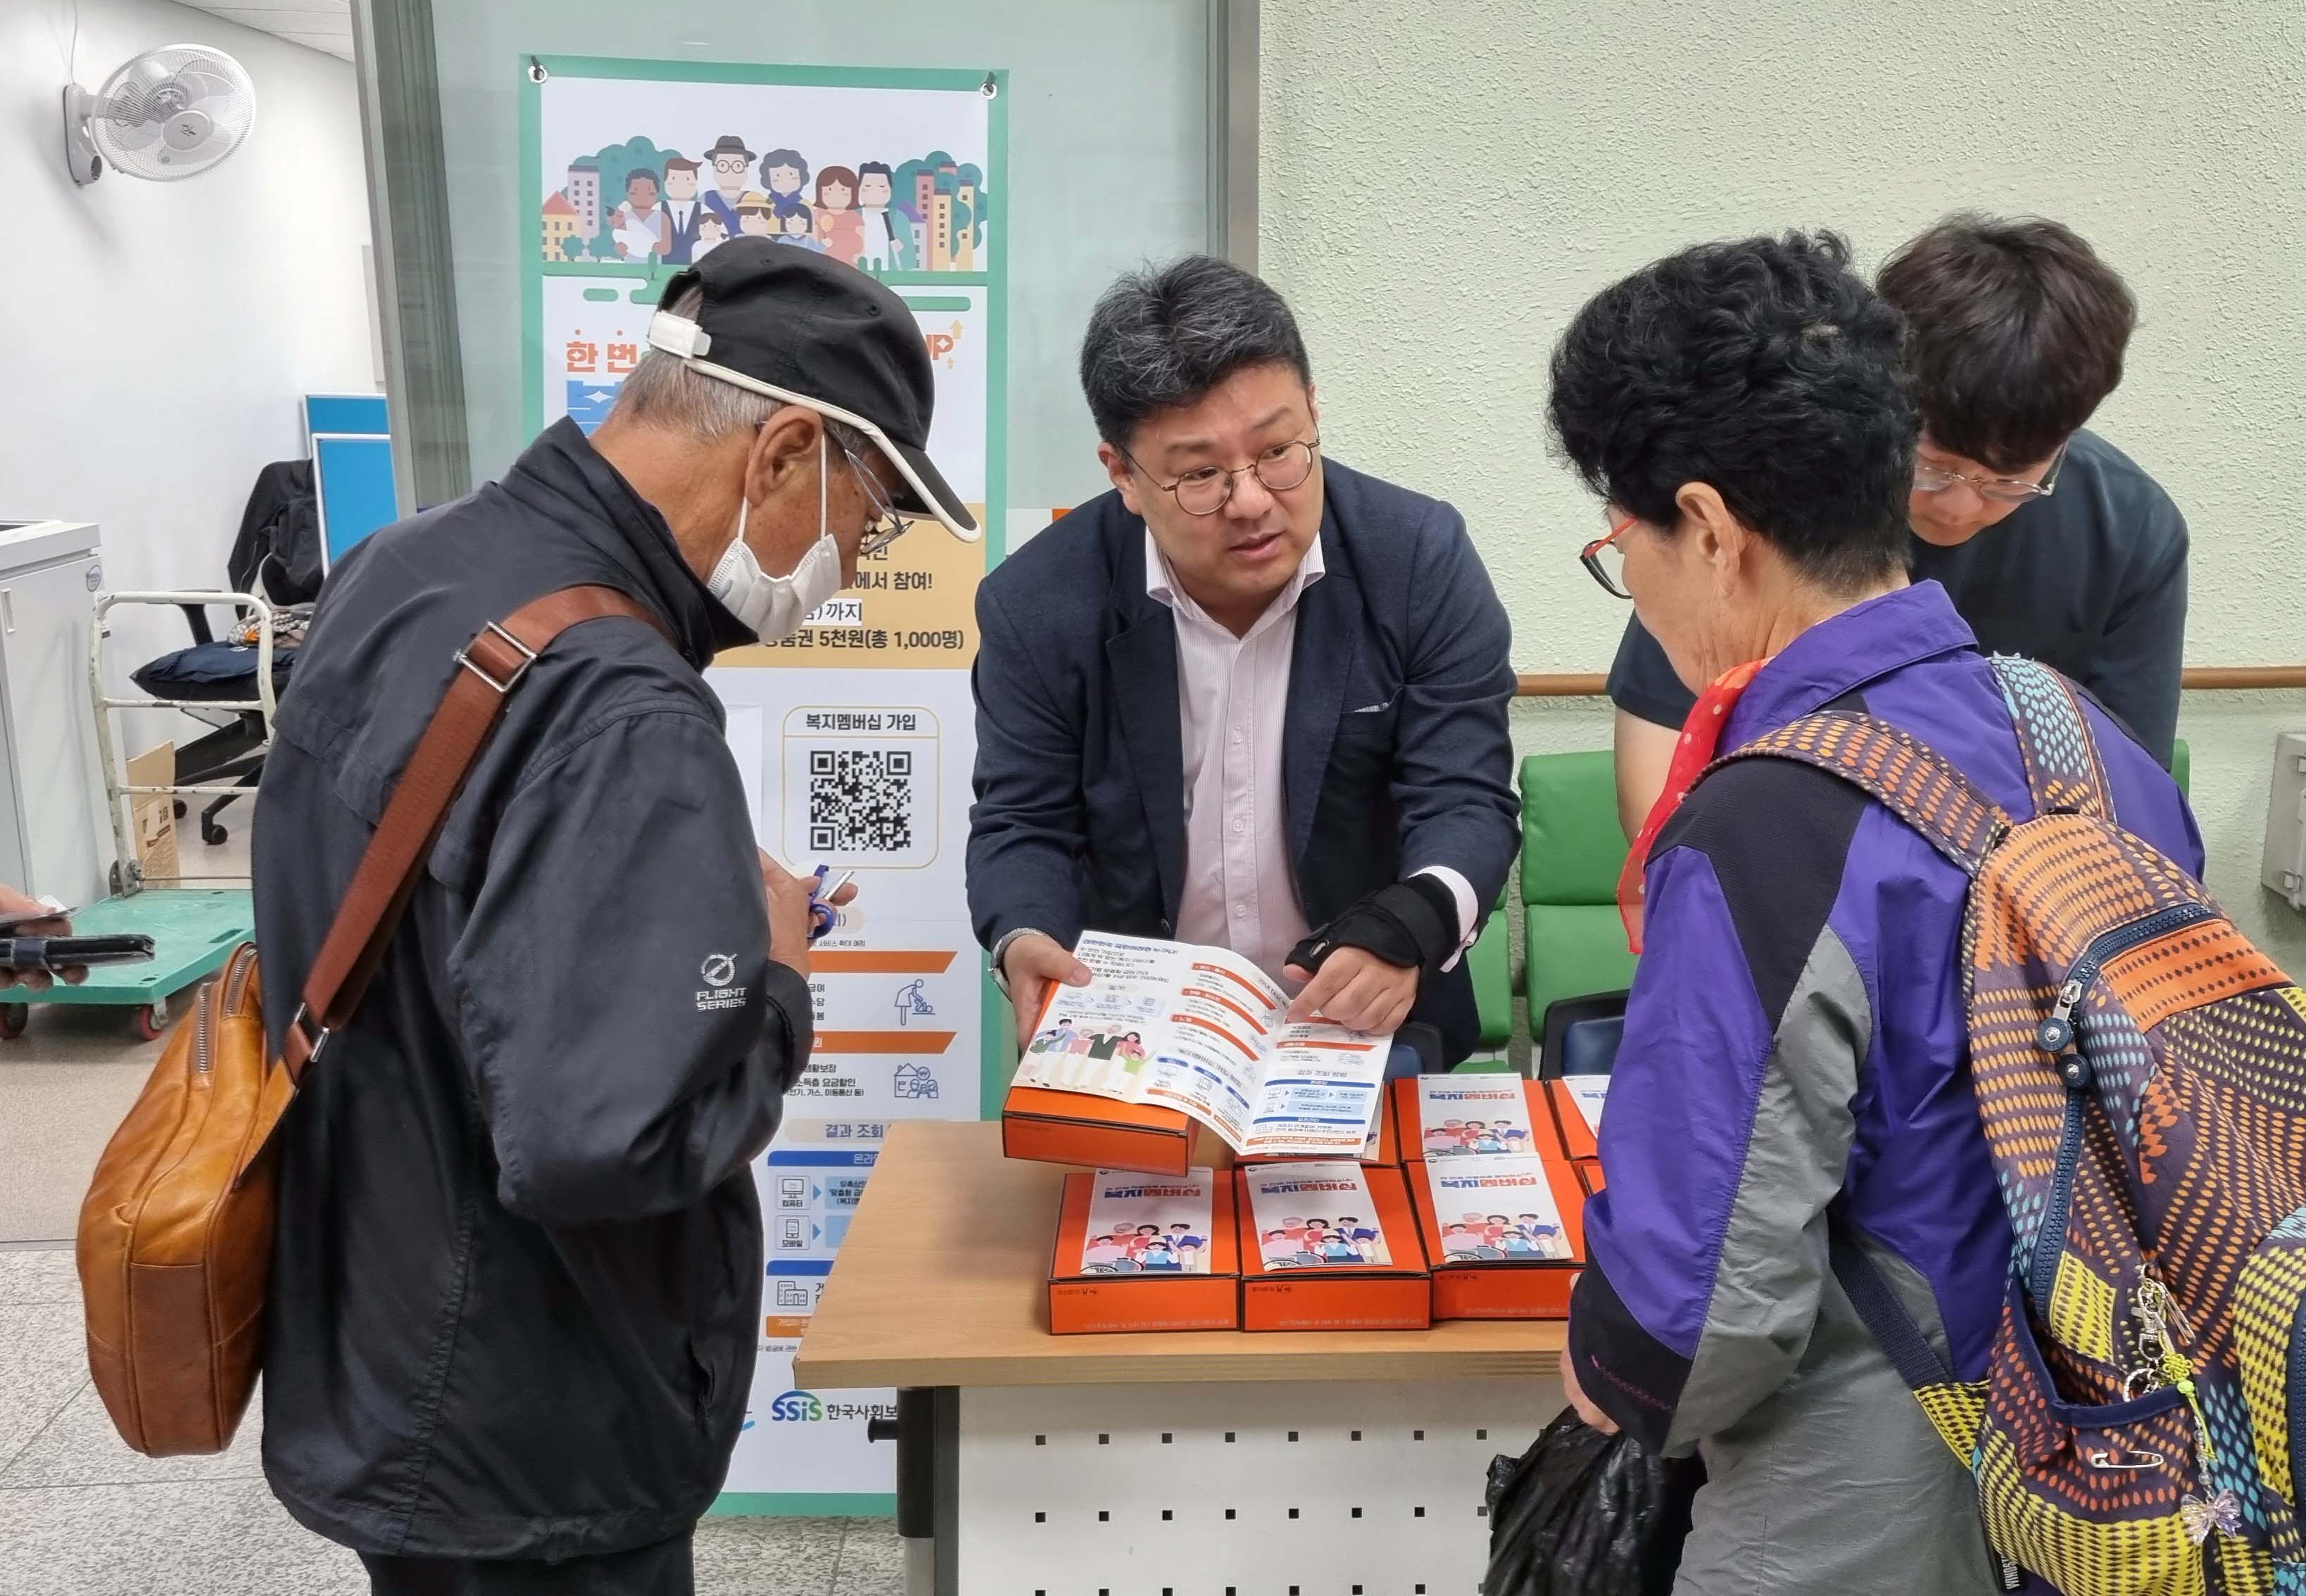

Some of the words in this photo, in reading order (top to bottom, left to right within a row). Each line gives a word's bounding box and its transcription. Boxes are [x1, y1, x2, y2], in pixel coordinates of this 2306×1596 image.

[926, 334, 954, 360] P
[567, 341, 598, 372] 한
[607, 343, 637, 373] 번
[893, 571, 933, 590] 참여!
[819, 629, 888, 649] 5천원(총
[894, 630, 964, 650] 1,000명)
[806, 714, 882, 730] 복지멤버십
[886, 714, 916, 730] 가입
[696, 987, 748, 1001] FLIGHT
[698, 998, 747, 1011] SERIES
[825, 1124, 853, 1138] 결과
[856, 1124, 884, 1138] 조회
